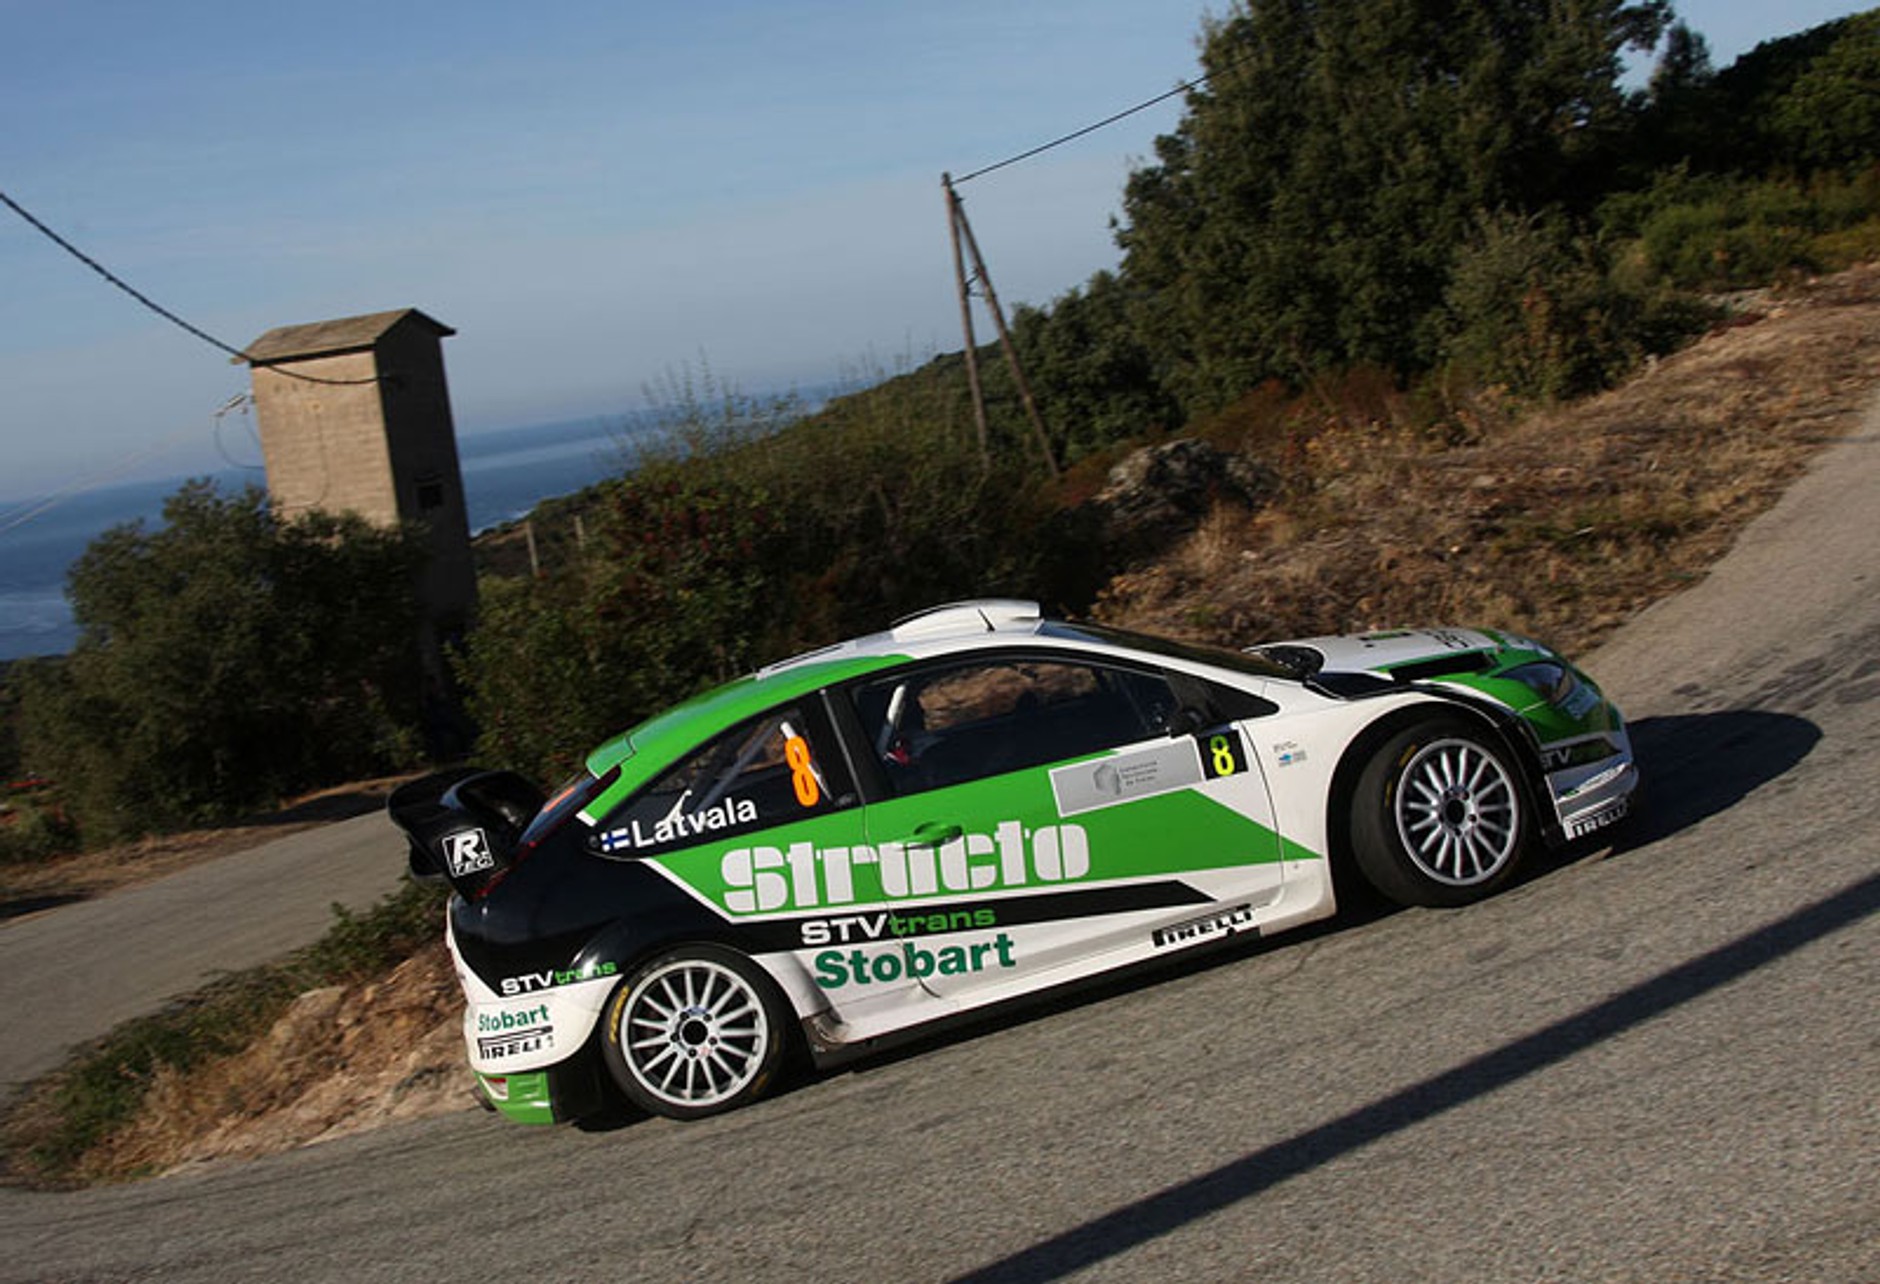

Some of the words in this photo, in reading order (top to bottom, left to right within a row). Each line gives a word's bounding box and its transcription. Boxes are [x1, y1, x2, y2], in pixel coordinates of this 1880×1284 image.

[784, 735, 819, 808] 8
[1209, 735, 1236, 776] 8
[632, 797, 758, 848] Latvala
[720, 819, 1091, 914] Structo
[1152, 903, 1253, 947] PIRELLI
[814, 933, 1017, 989] Stobart
[478, 1003, 550, 1032] Stobart
